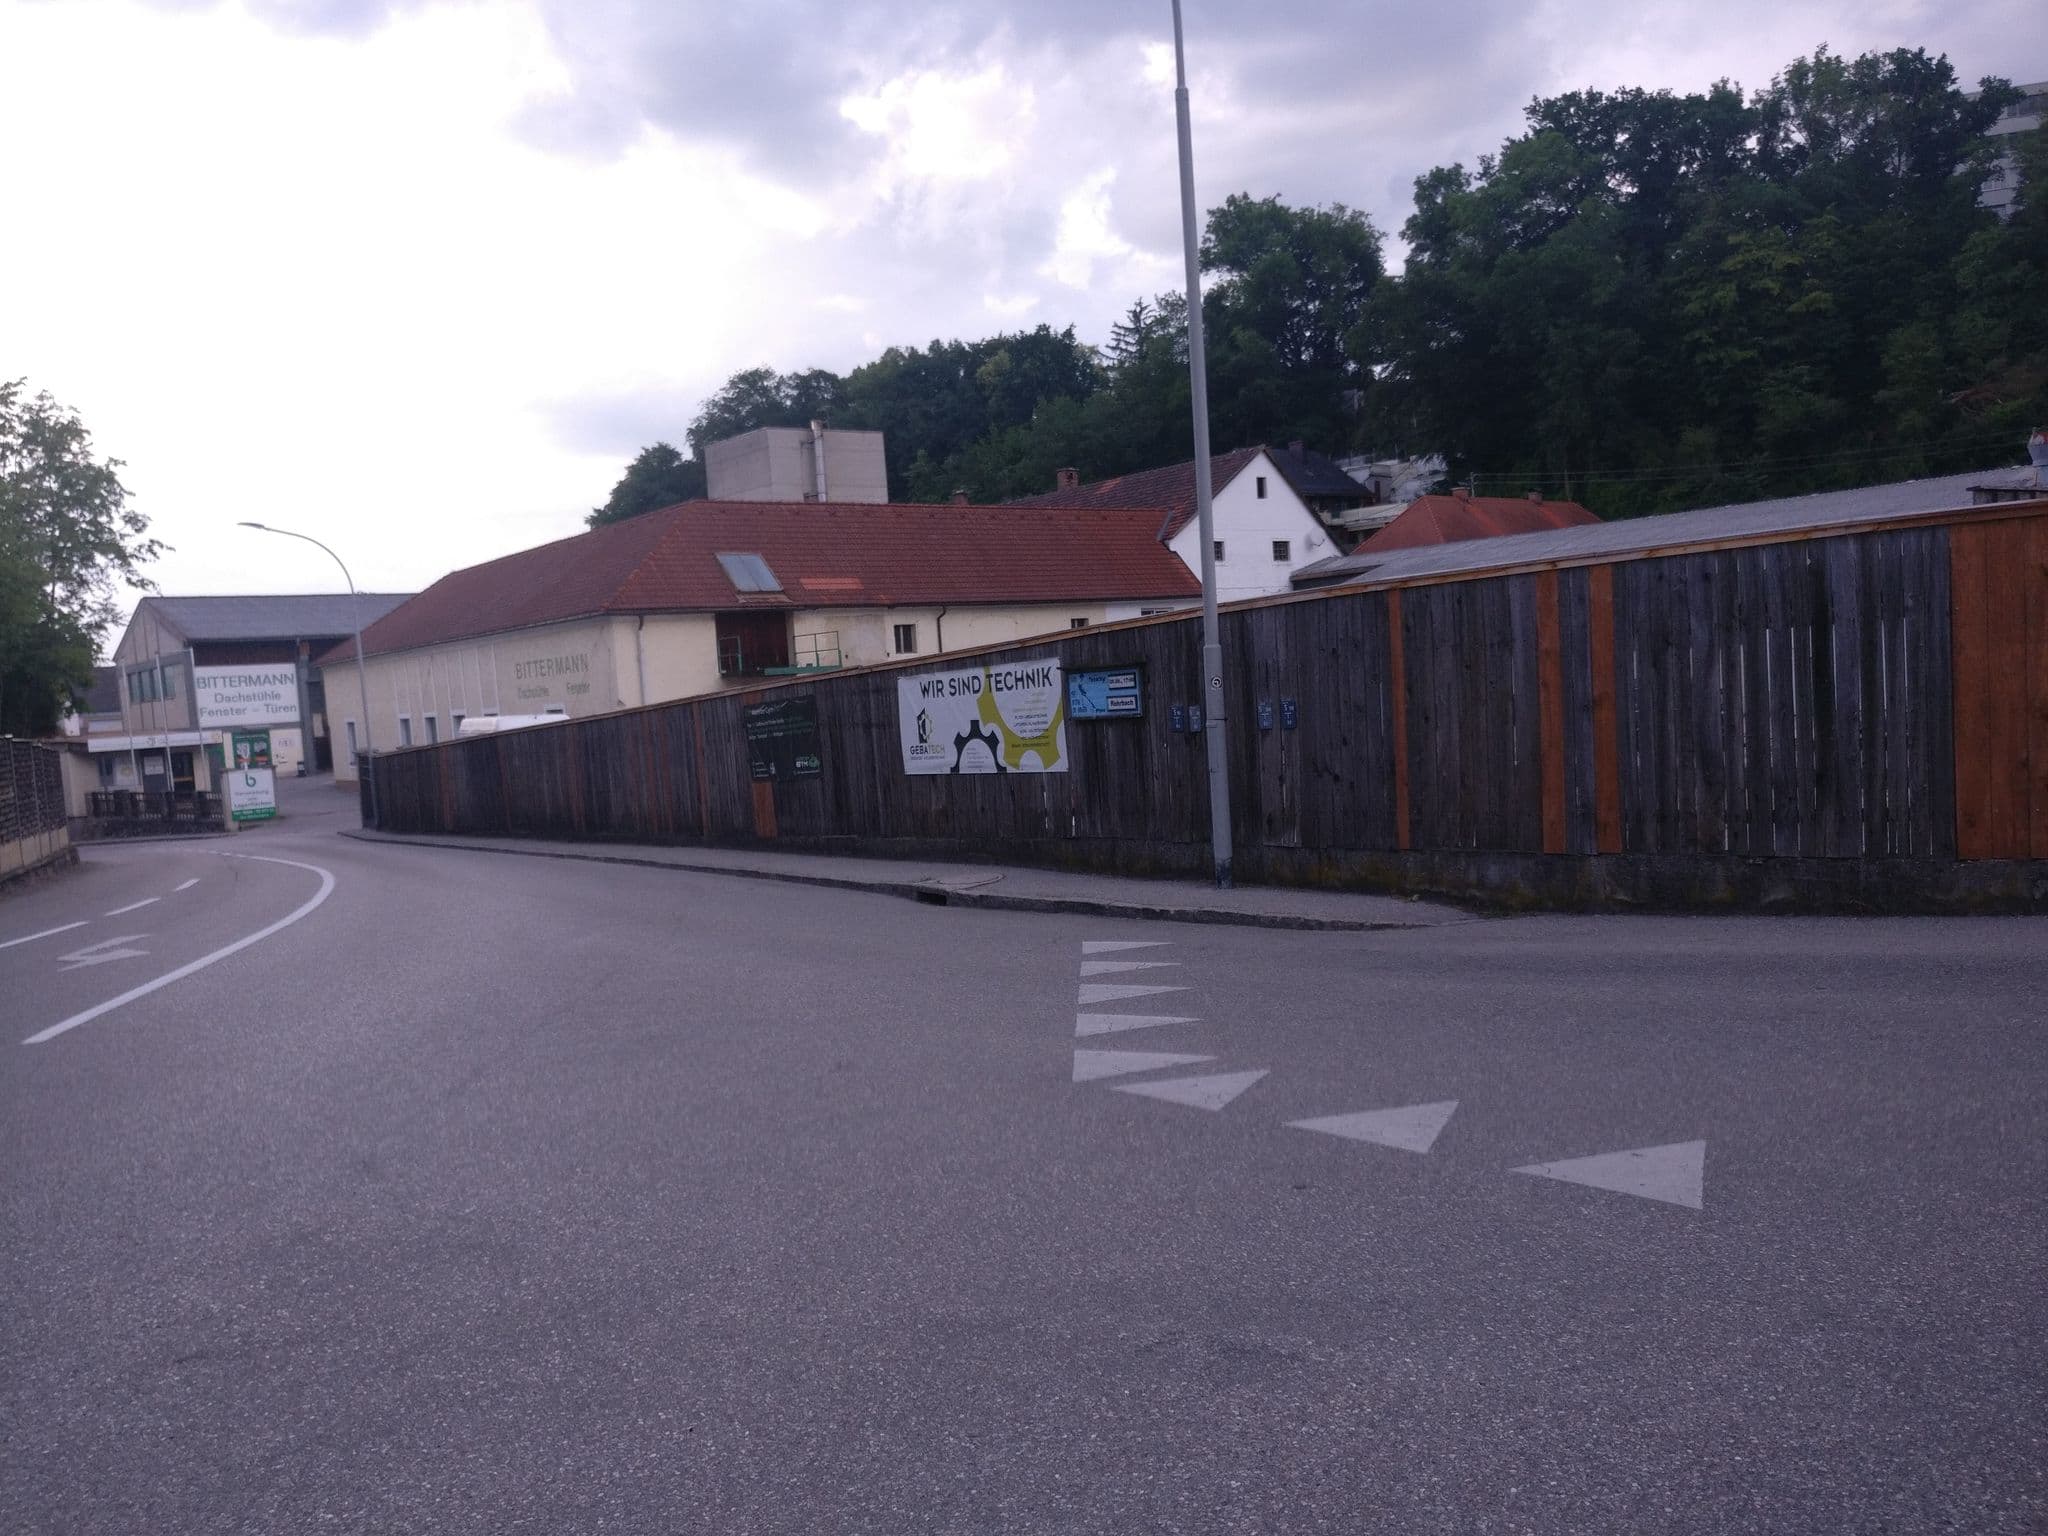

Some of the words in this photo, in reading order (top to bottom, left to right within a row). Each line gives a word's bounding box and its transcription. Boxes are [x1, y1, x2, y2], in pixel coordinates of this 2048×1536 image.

[515, 654, 590, 679] BITTERMANN
[196, 673, 295, 689] BITTERMANN
[919, 678, 946, 698] WIR
[949, 675, 982, 697] SIND
[985, 666, 1053, 693] TECHNIK
[214, 691, 281, 703] Dachstühle
[199, 707, 247, 717] Fenster
[264, 703, 298, 713] Türen
[909, 744, 945, 755] GEBATECH
